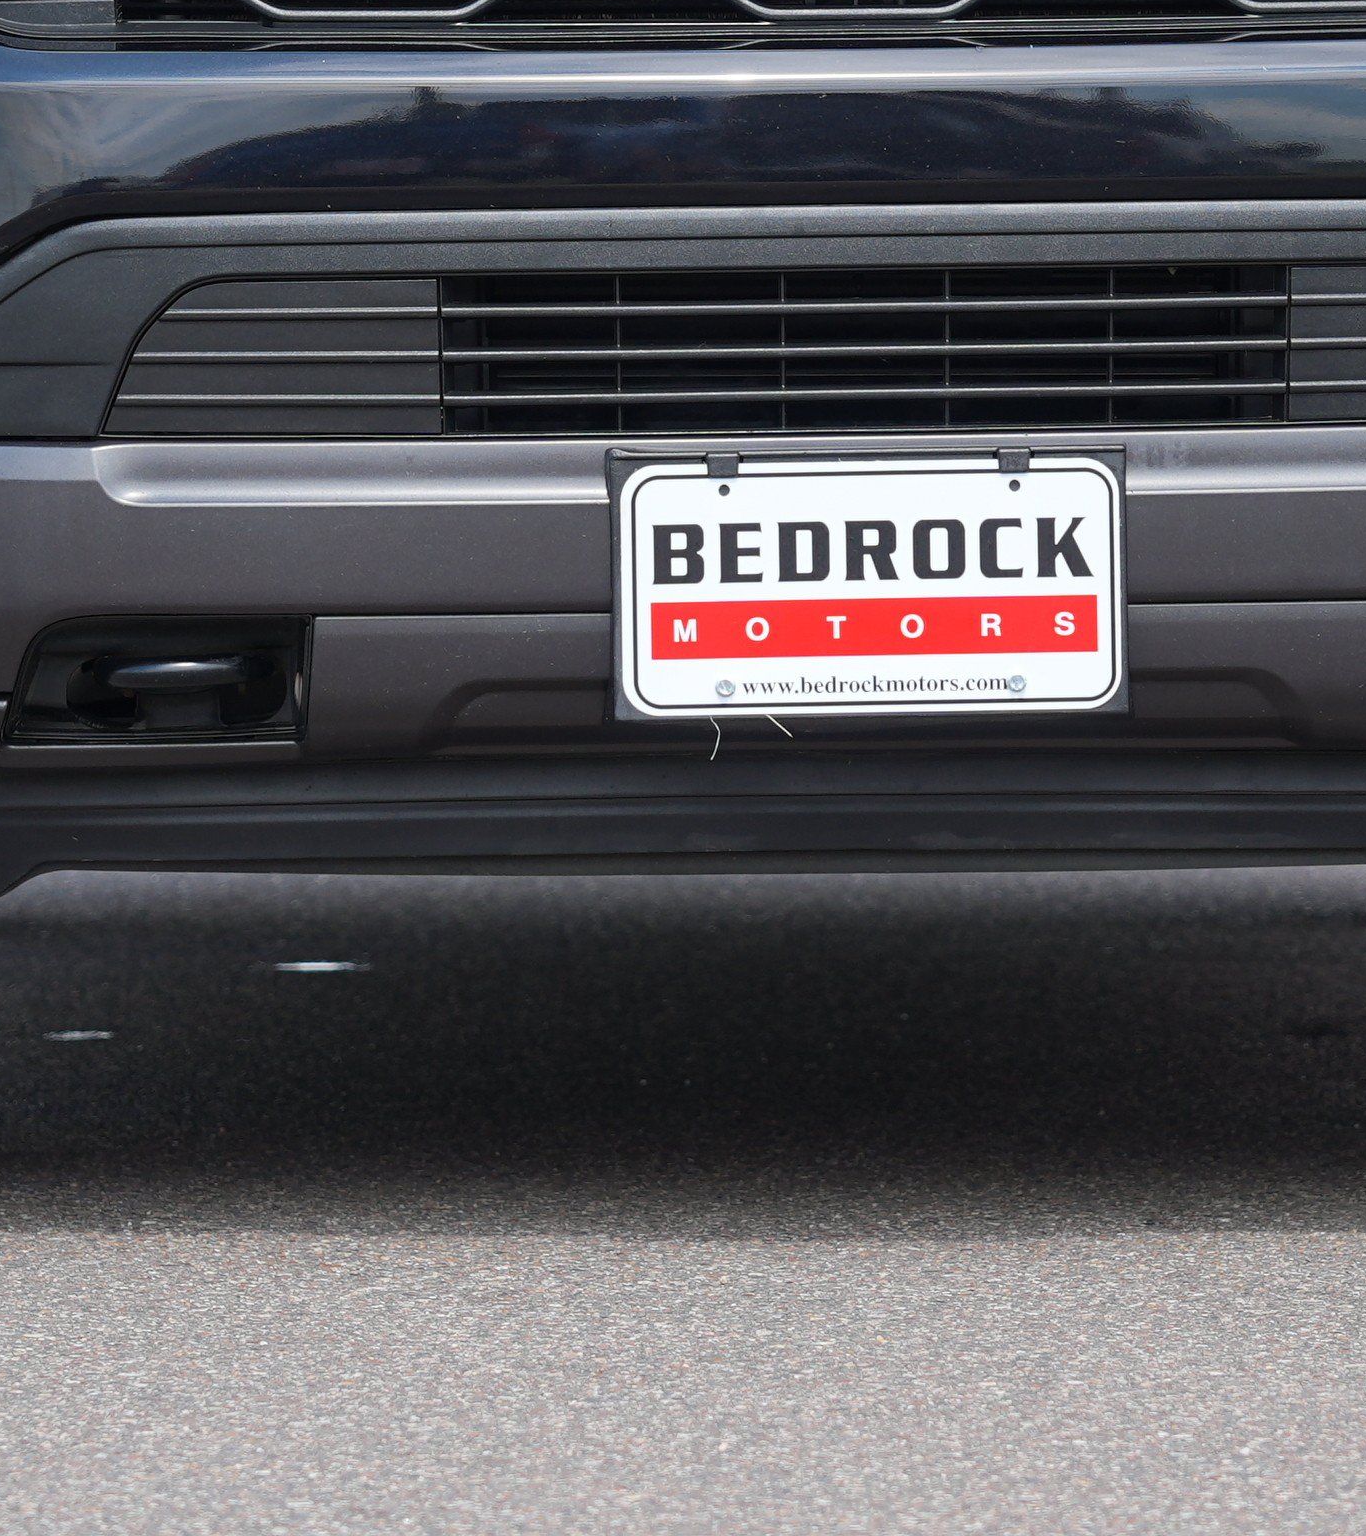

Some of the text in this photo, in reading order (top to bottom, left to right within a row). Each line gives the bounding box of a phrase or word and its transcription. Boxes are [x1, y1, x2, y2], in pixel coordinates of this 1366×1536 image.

[651, 516, 1095, 585] BEDROCK
[672, 611, 1077, 644] MOTORS
[741, 674, 1008, 695] www.bedrockmotors.com
